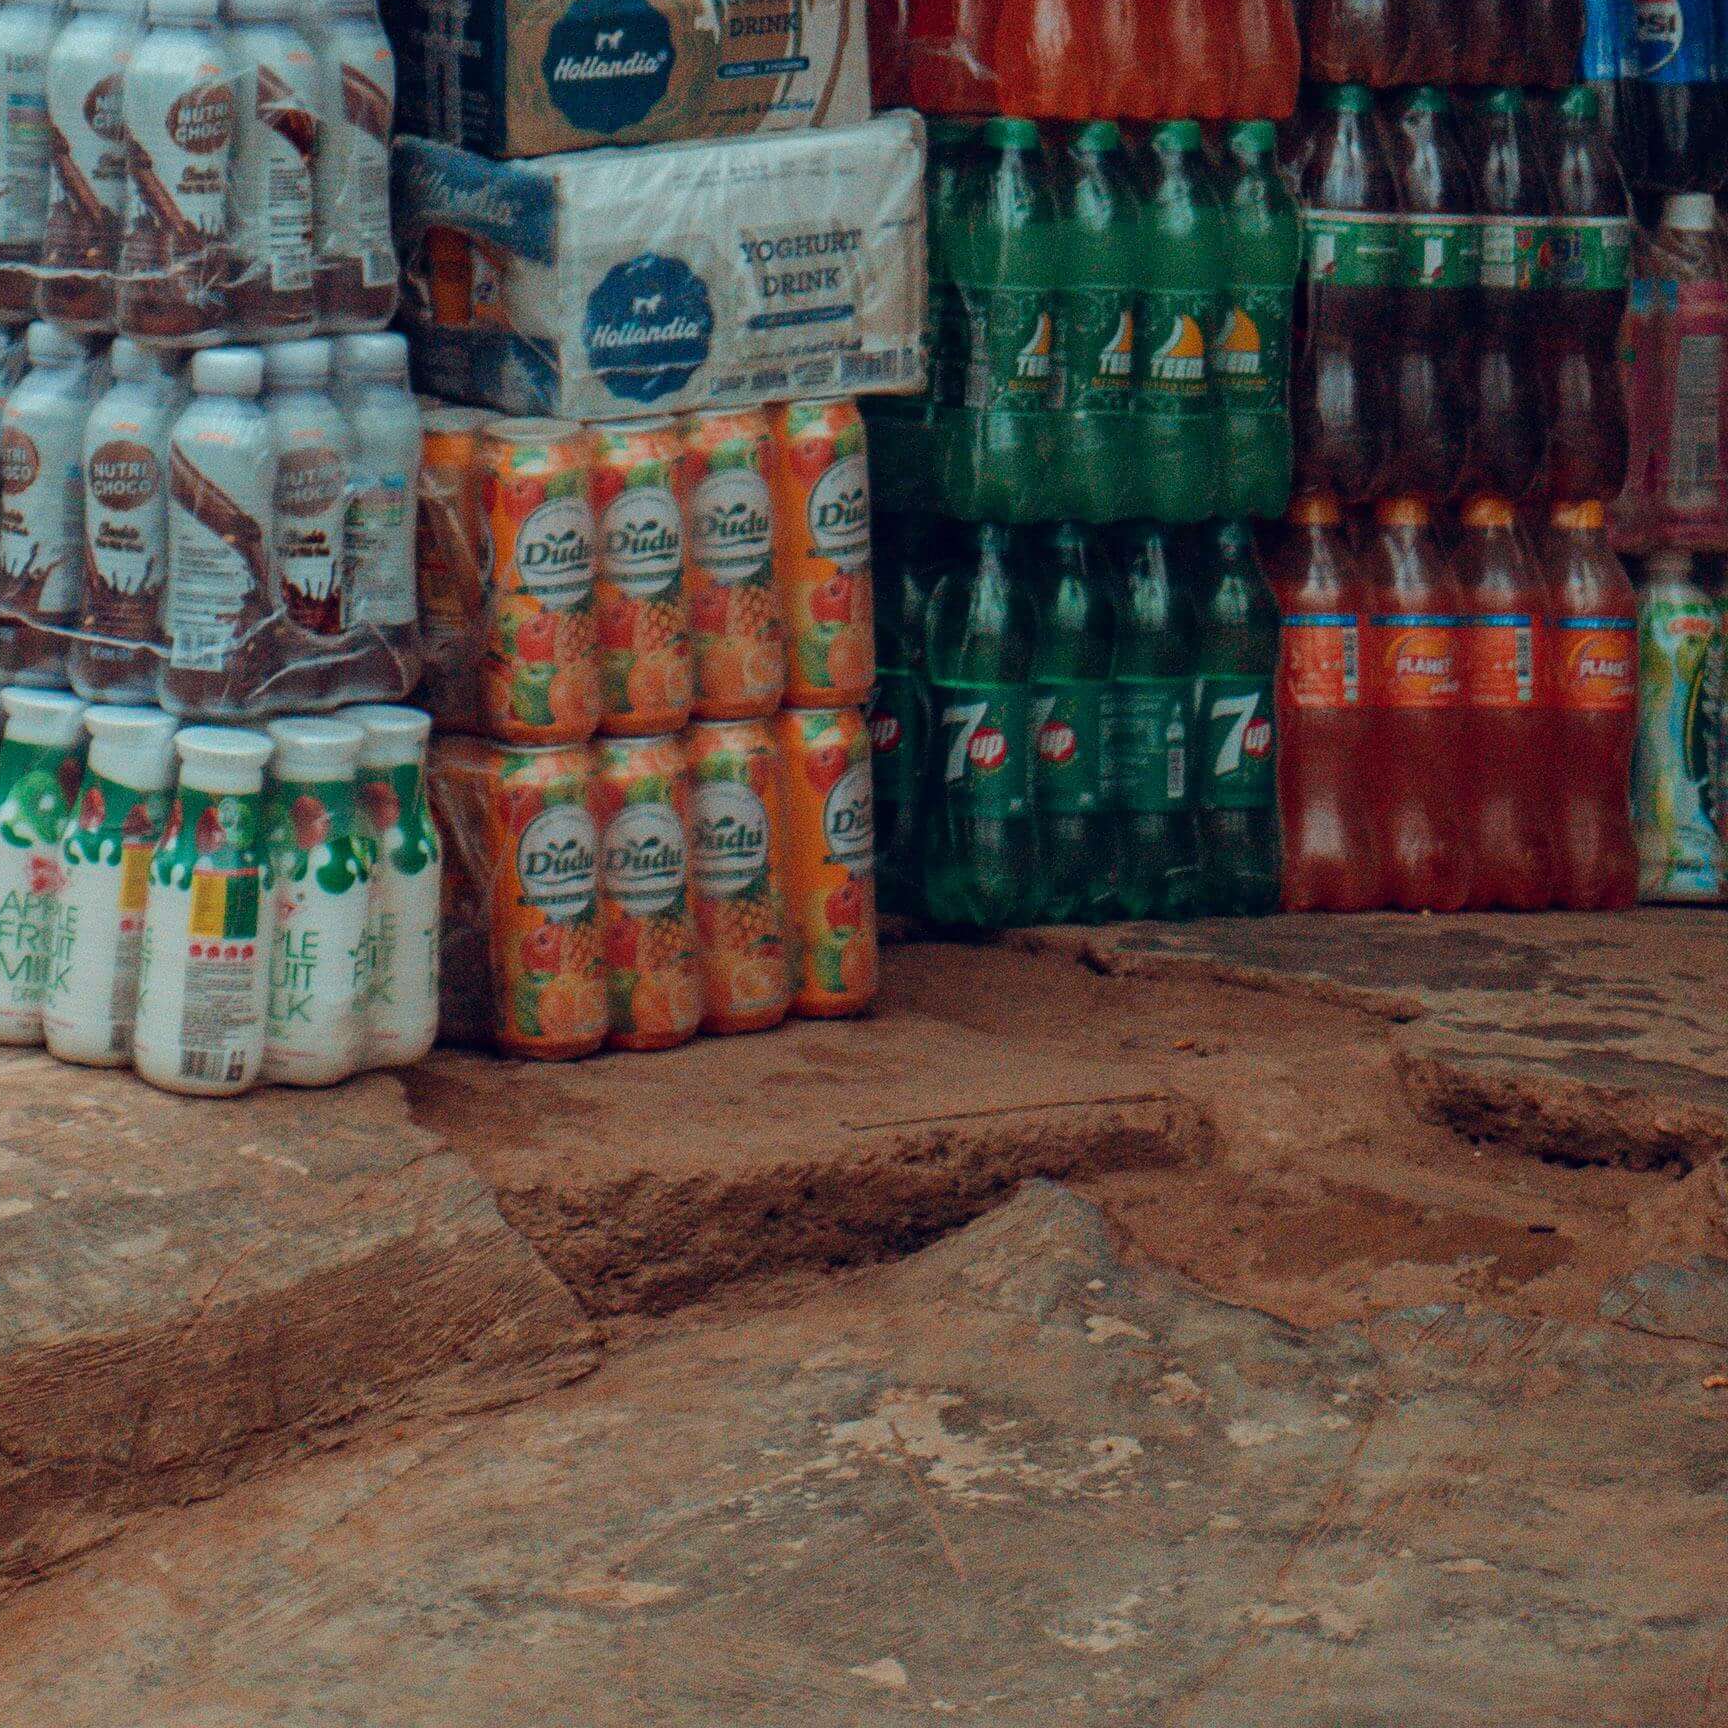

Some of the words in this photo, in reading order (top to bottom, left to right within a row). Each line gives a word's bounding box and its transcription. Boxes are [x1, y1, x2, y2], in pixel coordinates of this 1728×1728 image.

[729, 11, 799, 38] DRINK
[553, 53, 661, 83] Hollandia
[740, 229, 863, 266] YOGHURT
[763, 267, 842, 299] DRINK
[592, 315, 700, 347] Hollandia
[93, 462, 147, 480] NUTRI
[92, 479, 152, 496] CHOCO
